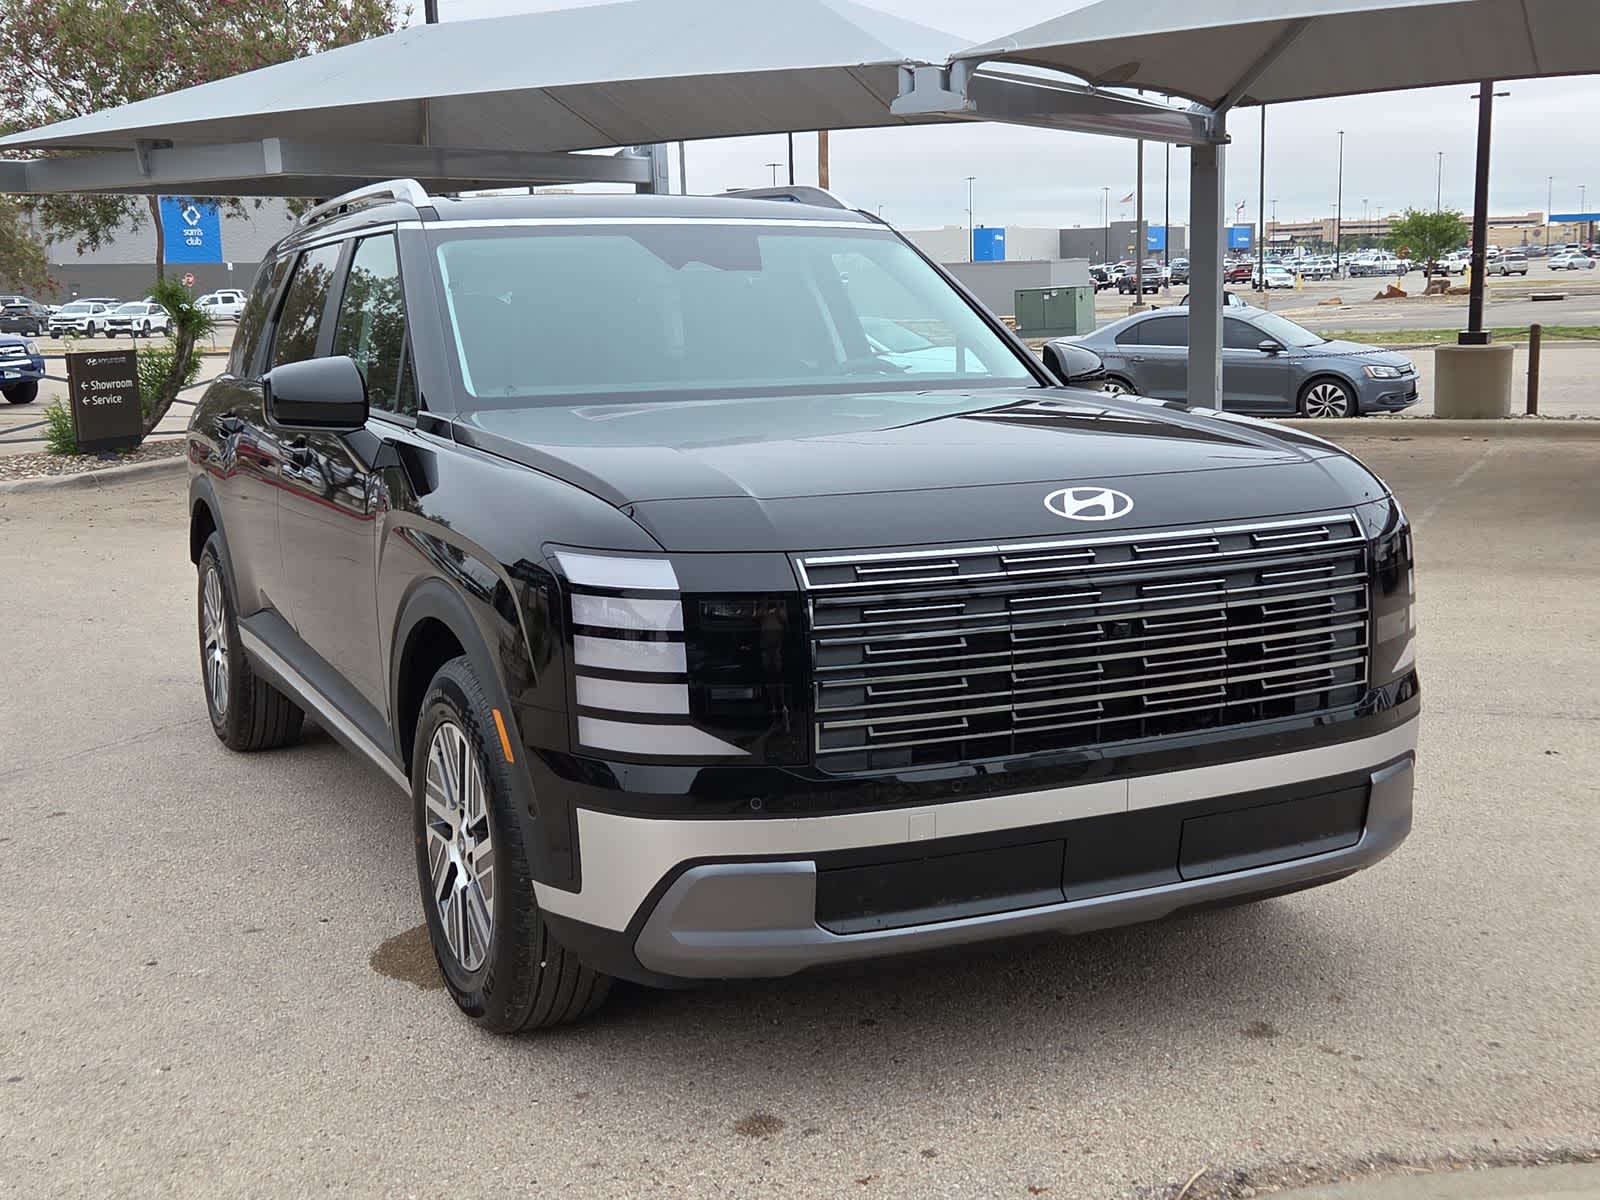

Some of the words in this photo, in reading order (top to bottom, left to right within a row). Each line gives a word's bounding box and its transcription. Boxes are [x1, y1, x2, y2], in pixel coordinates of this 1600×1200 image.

[186, 237, 202, 246] club
[90, 380, 133, 390] Showroom
[92, 394, 122, 405] Service
